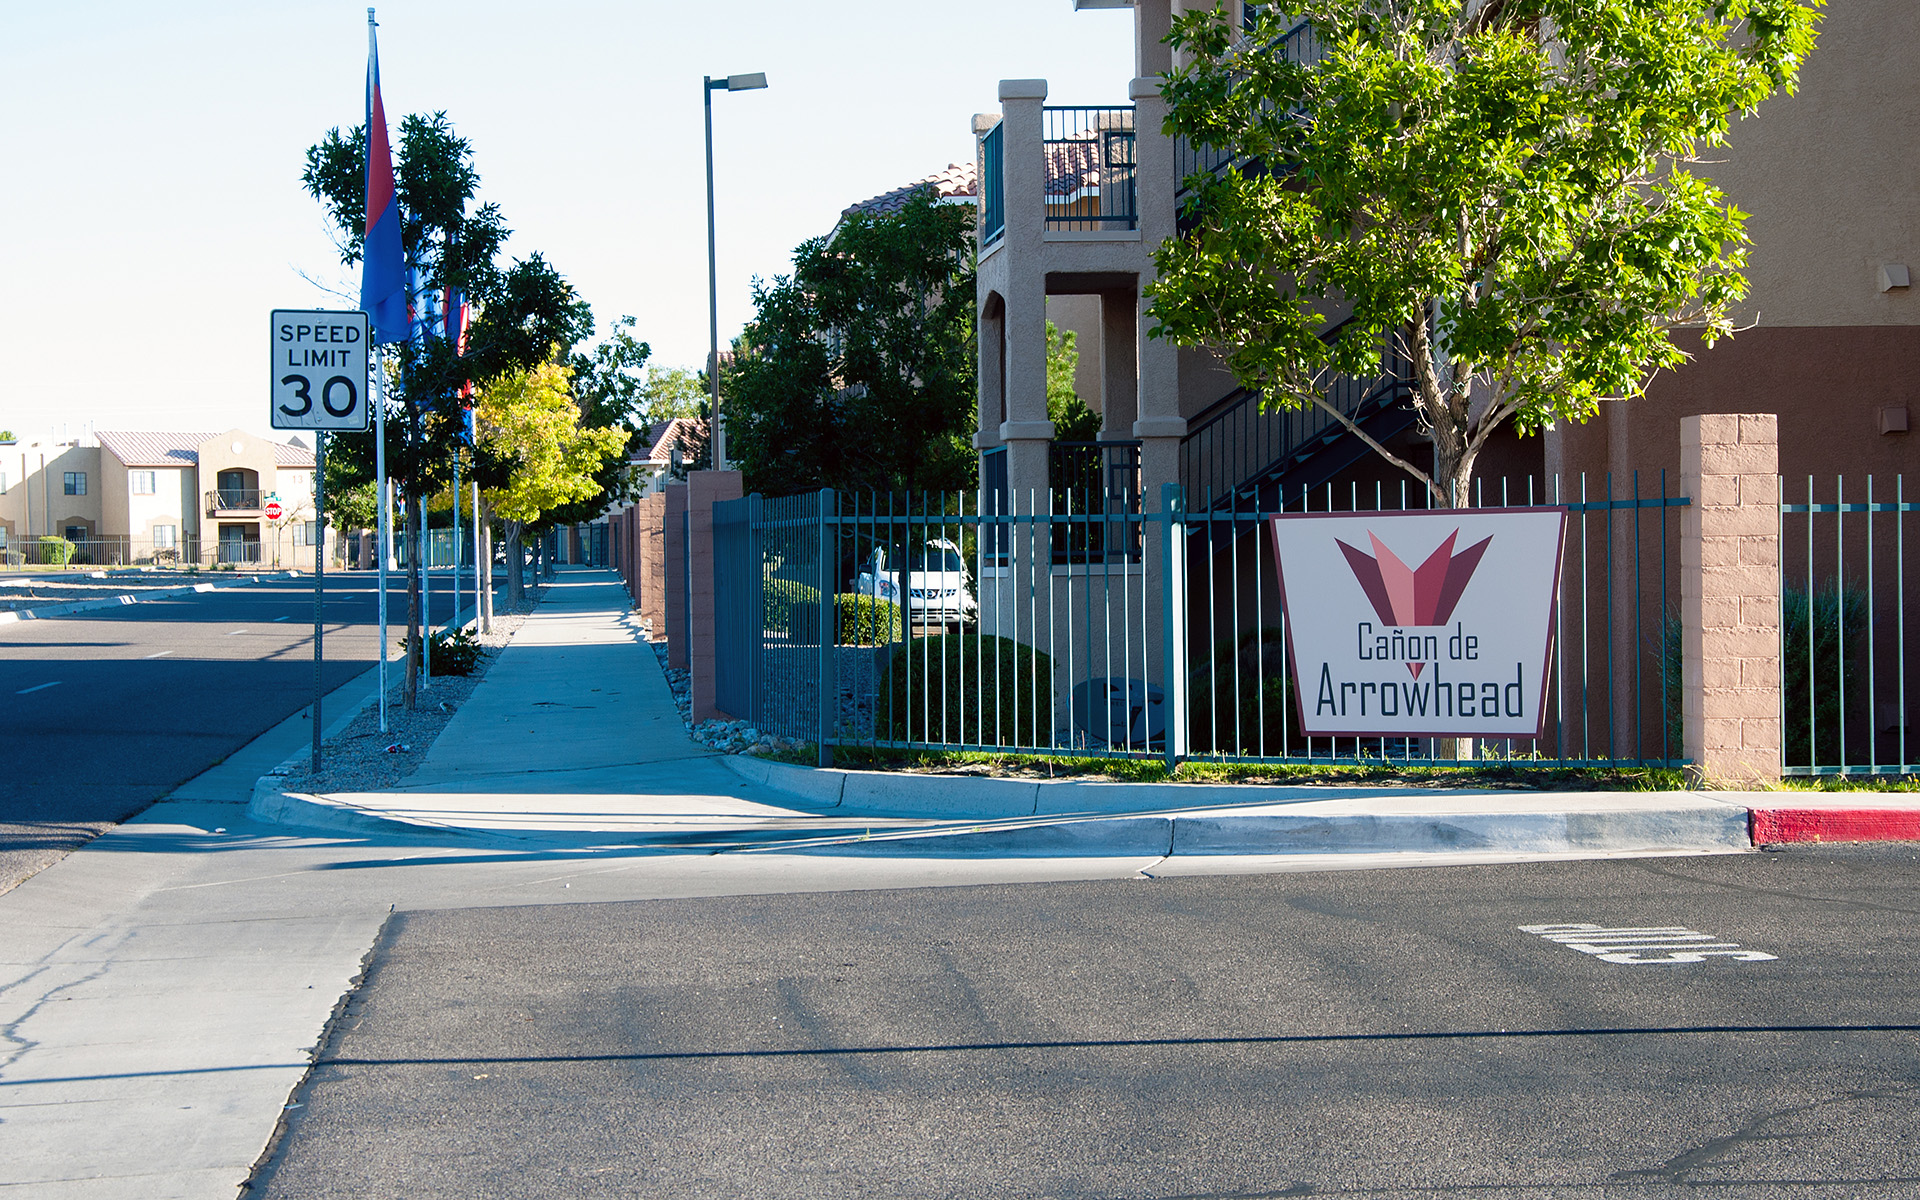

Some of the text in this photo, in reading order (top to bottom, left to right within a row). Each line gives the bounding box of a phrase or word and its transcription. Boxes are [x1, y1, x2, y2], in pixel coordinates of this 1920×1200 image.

[280, 324, 360, 343] SPEED
[288, 349, 351, 367] LIMIT
[279, 374, 358, 418] 30
[265, 507, 282, 515] STOP
[1358, 621, 1478, 660] Cañon de
[1316, 662, 1523, 718] Arrowhead
[1517, 923, 1780, 964] STOP
